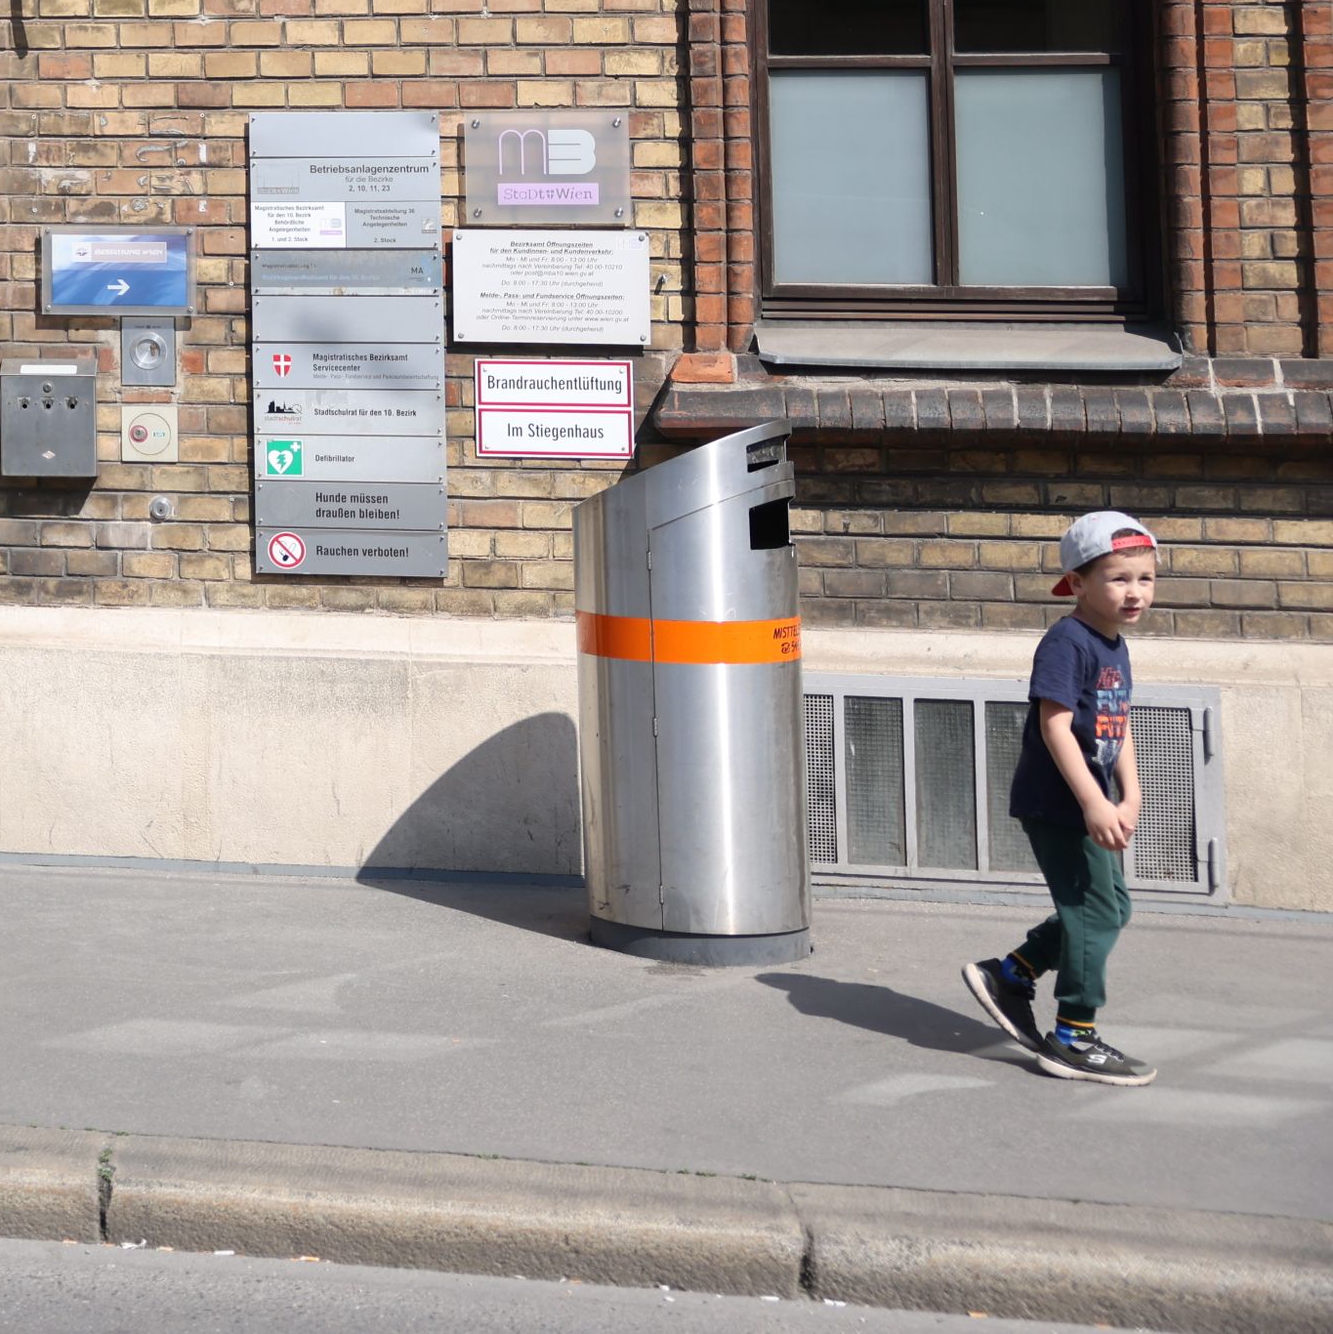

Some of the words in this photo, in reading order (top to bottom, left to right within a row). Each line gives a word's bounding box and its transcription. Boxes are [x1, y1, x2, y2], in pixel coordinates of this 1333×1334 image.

[309, 164, 429, 175] Betriebsanlagenzentrum
[411, 267, 424, 275] MA
[312, 353, 367, 362] Magistratisches
[369, 353, 408, 362] Bezirksamt
[312, 363, 360, 372] Servicecenter
[487, 375, 622, 394] Brandrauchentlüftung
[314, 408, 358, 416] Stadtschulrat
[359, 408, 368, 416] für
[370, 408, 382, 416] den
[396, 409, 417, 417] Bezirk
[507, 423, 523, 437] Im
[528, 423, 604, 441] Stiegenhaus
[315, 454, 355, 462] Defibrillator
[315, 492, 347, 503] Hunde
[350, 493, 388, 504] müssen
[315, 507, 356, 519] draußen
[359, 508, 400, 520] bleiben!
[316, 545, 359, 556] Rauchen
[362, 547, 409, 558] verboten!
